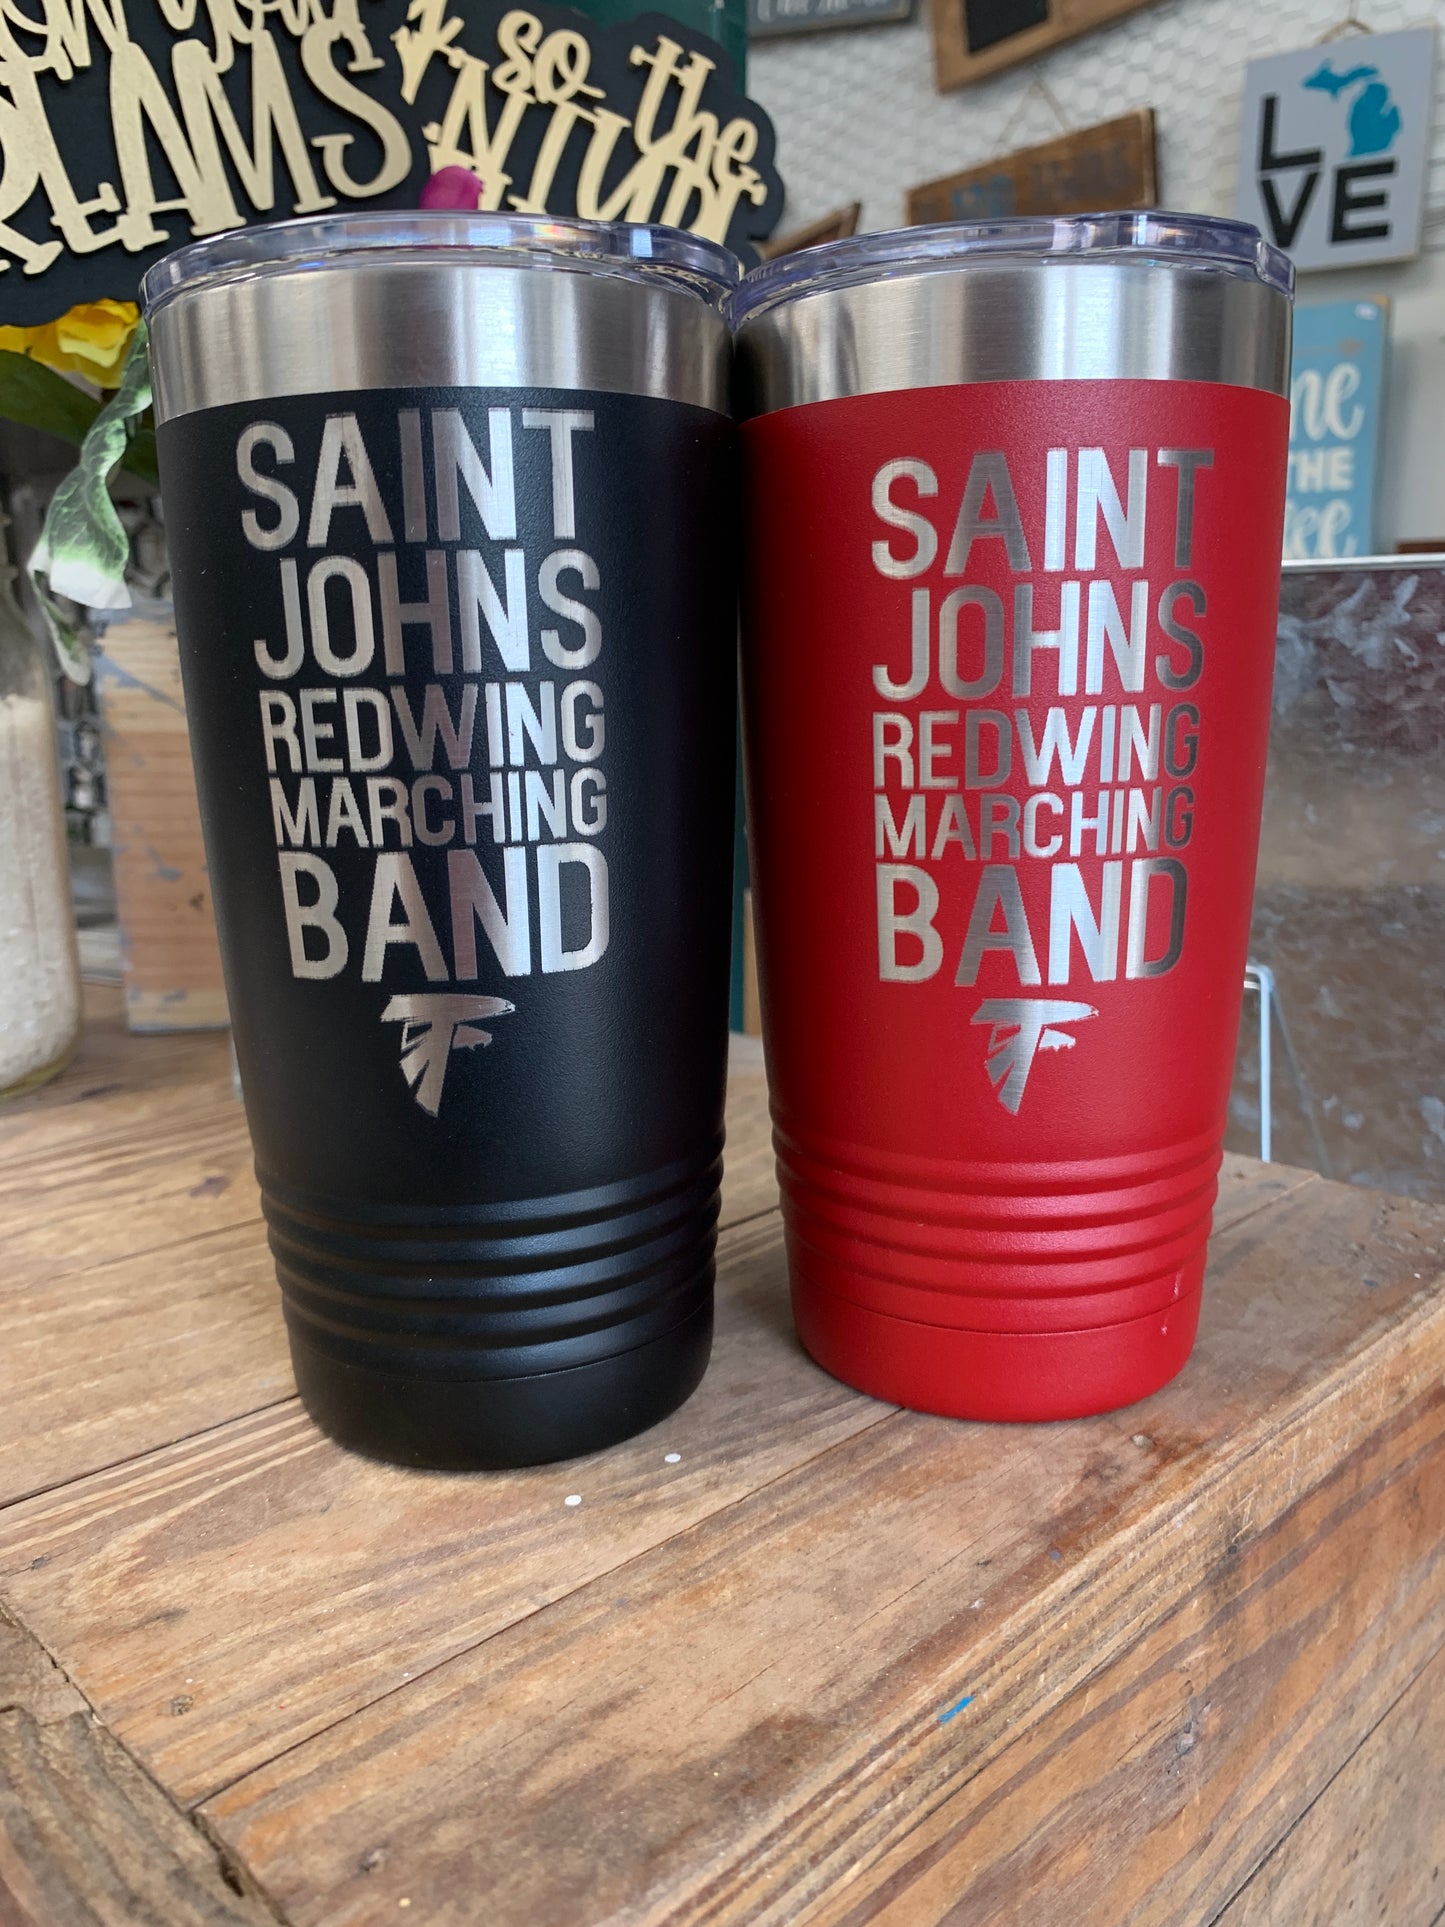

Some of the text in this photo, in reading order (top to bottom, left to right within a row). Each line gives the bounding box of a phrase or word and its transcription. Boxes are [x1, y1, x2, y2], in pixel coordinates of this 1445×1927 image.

[0, 18, 413, 275] REAMS
[492, 9, 606, 104] so
[629, 35, 760, 190] the
[1288, 362, 1366, 442] ne
[236, 407, 596, 551] SAINT
[870, 447, 1215, 580] SAINT
[254, 548, 602, 679] JOHNS
[872, 579, 1207, 701] JOHNS
[258, 680, 607, 774] REDWING
[872, 703, 1199, 791] REDWING
[268, 768, 609, 849] MARCHING
[874, 786, 1194, 860] MARCHING
[277, 842, 611, 983] BAND
[875, 857, 1189, 987] BAND
